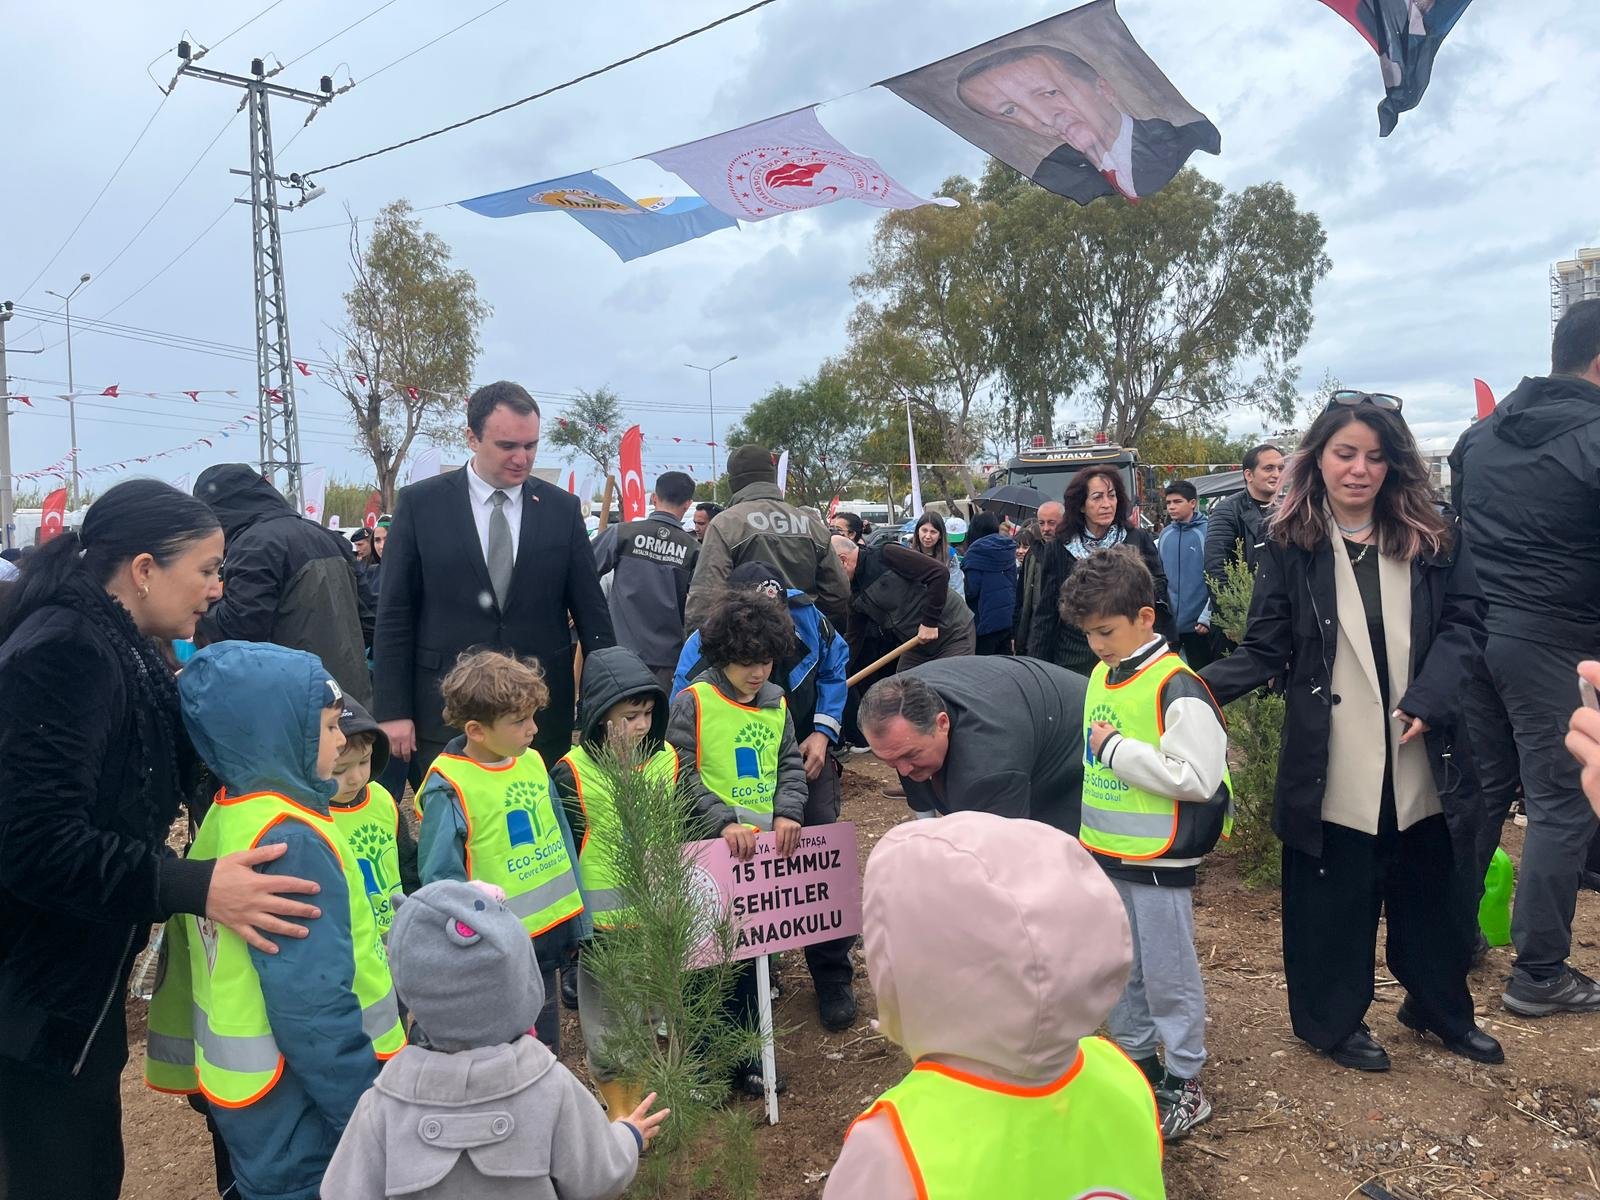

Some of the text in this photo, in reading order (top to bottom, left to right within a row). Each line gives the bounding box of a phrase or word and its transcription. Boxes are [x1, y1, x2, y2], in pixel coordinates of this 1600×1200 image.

[1046, 452, 1093, 461] ANTALYA
[747, 511, 809, 534] OGN
[634, 534, 688, 559] ORMAN
[795, 836, 826, 850] ATPAŞA
[732, 862, 756, 884] 15
[761, 850, 841, 880] TEMMUZ
[733, 882, 829, 920] ŞEHİTLER
[736, 910, 842, 949] ANAOKULU
